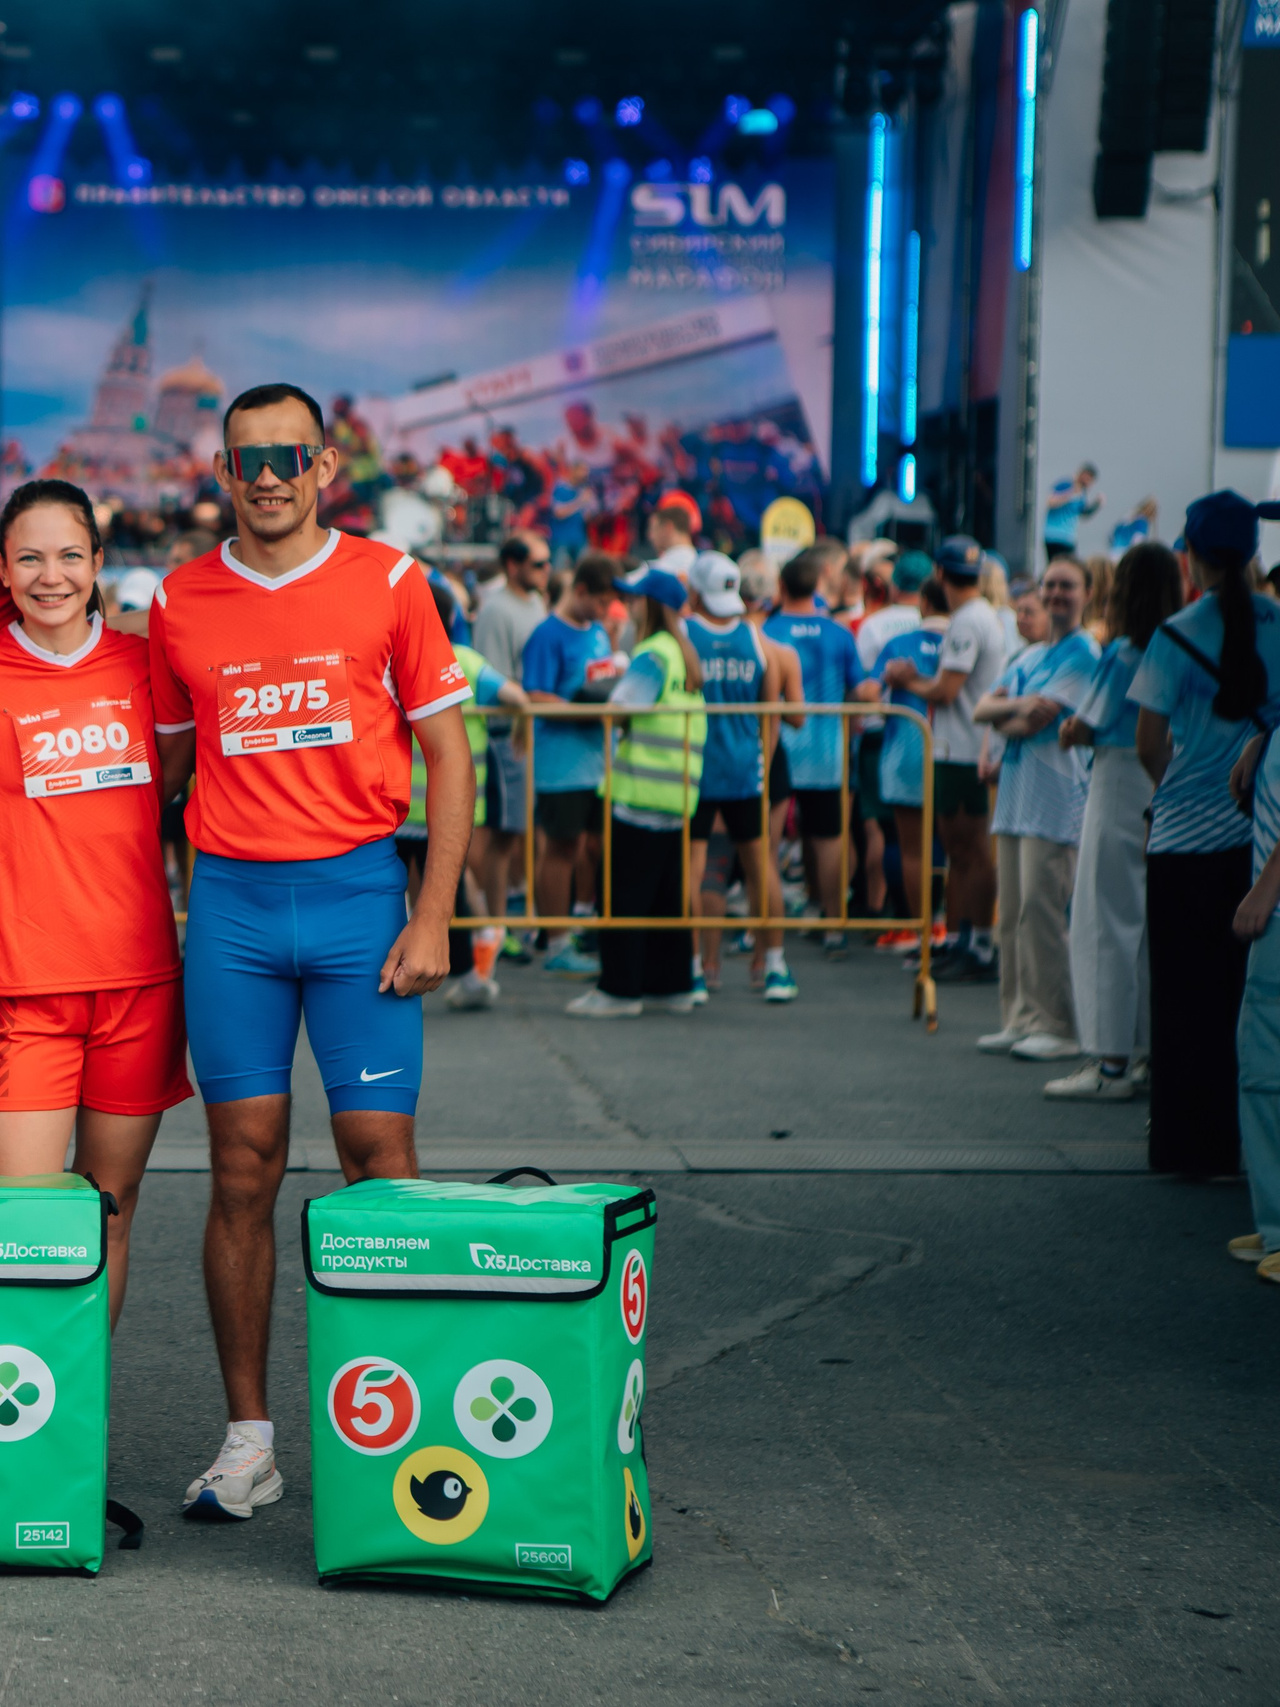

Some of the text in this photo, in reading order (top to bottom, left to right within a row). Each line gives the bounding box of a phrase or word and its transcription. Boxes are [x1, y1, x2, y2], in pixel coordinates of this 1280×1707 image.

[234, 679, 330, 717] 2875
[33, 722, 130, 761] 2080
[299, 732, 331, 740] Следопыт
[321, 1233, 430, 1250] Доставляем
[321, 1252, 408, 1271] продукты
[350, 1365, 400, 1437] 5
[23, 1529, 64, 1542] 25142
[521, 1551, 568, 1565] 25600
